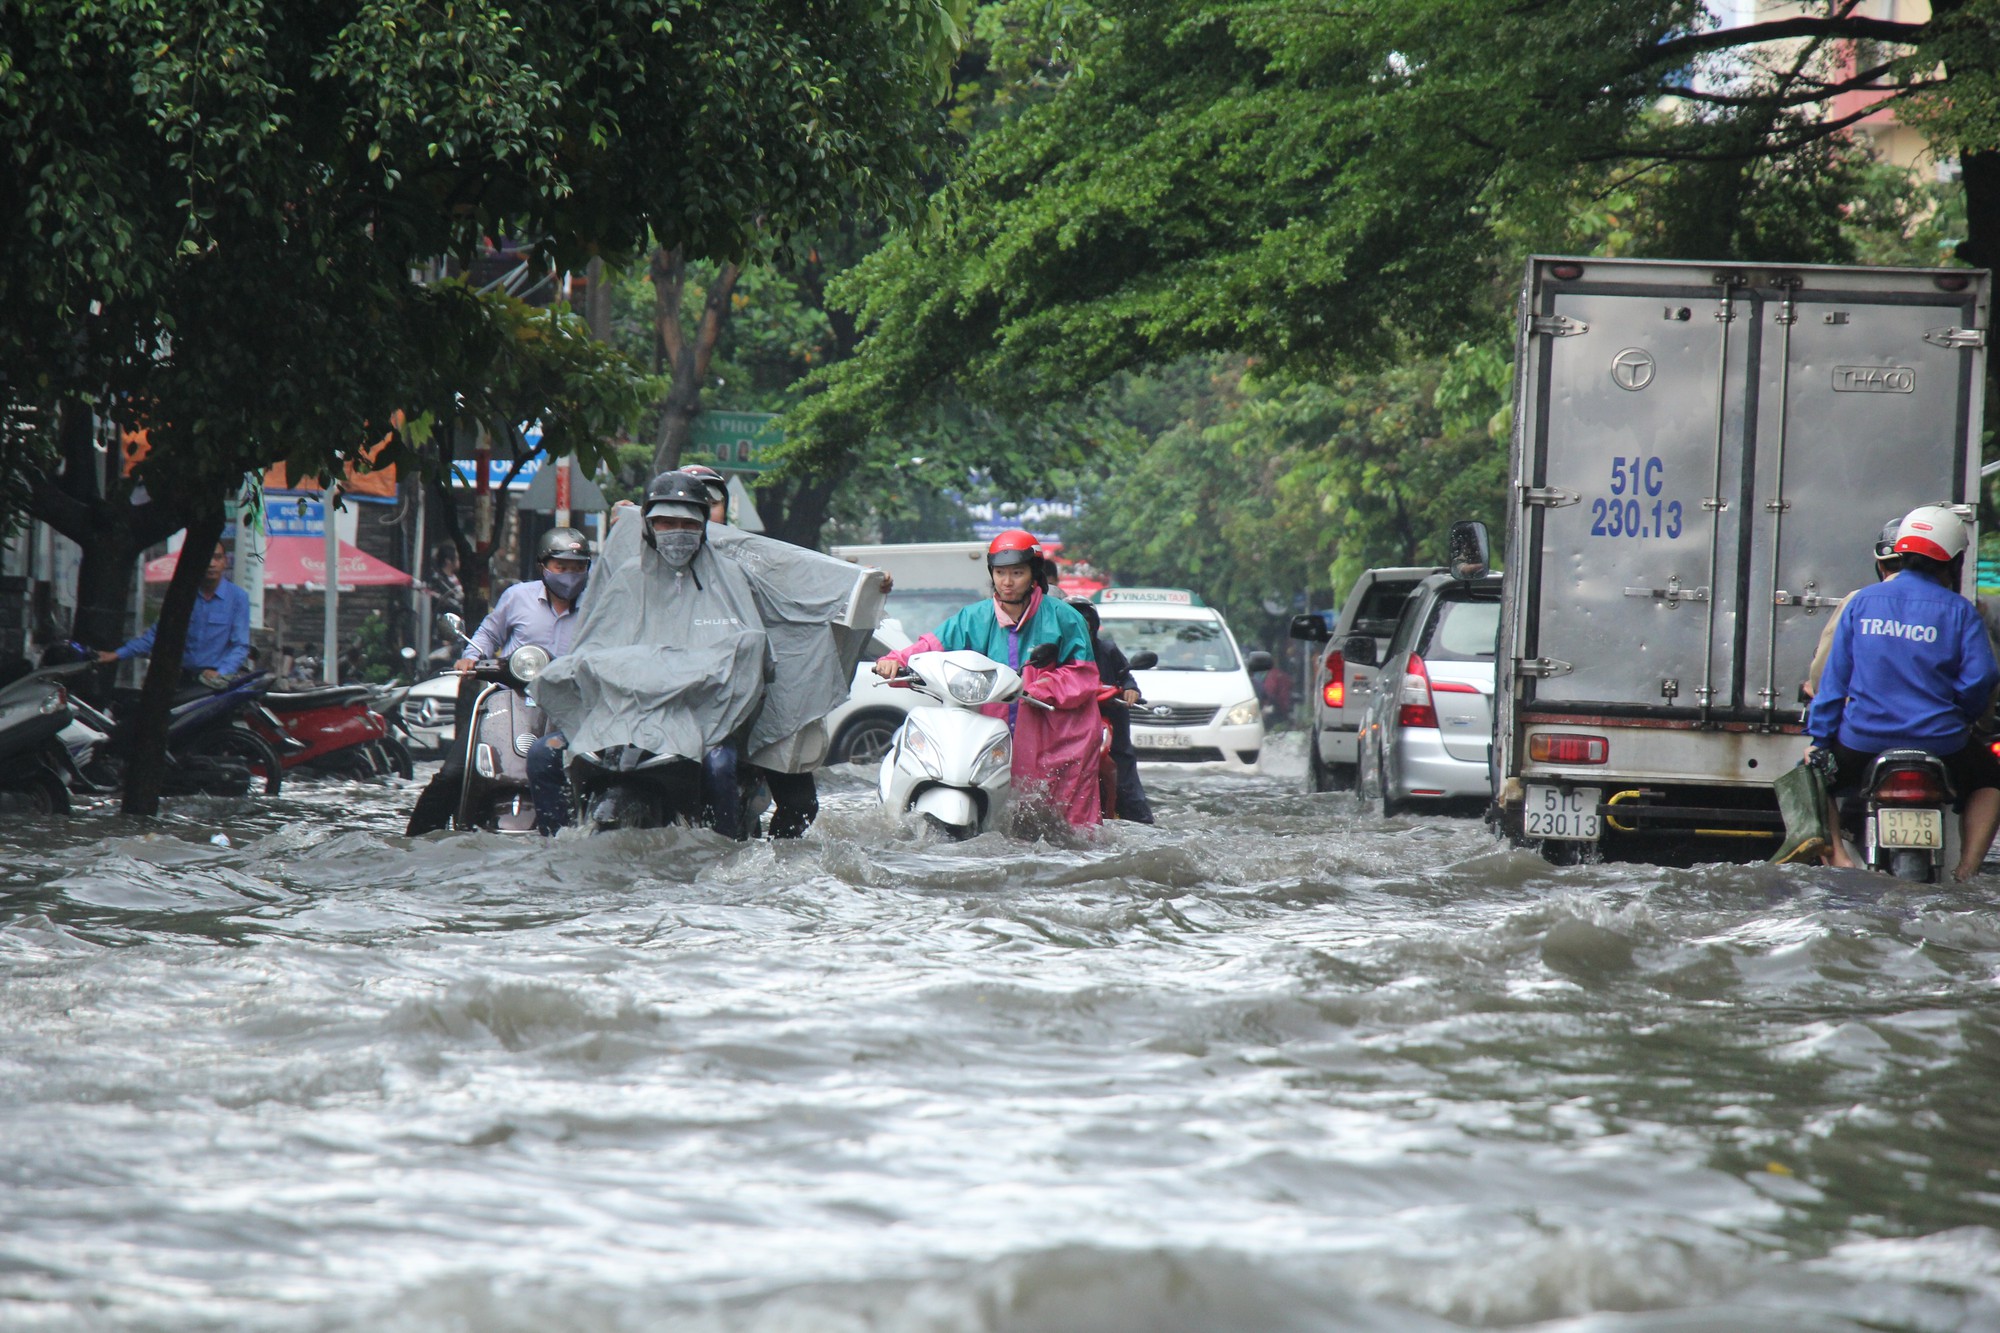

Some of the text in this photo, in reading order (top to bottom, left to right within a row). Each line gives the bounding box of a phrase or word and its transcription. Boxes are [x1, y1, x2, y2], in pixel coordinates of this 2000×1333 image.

[1836, 369, 1911, 389] THACO
[1610, 456, 1663, 497] 51C
[1590, 498, 1683, 539] 230.13
[1122, 592, 1168, 601] VINASUN
[1860, 618, 1938, 643] TRAVICO
[1545, 789, 1584, 813] 51C
[1529, 812, 1598, 837] 230.13
[1889, 829, 1933, 845] 8729
